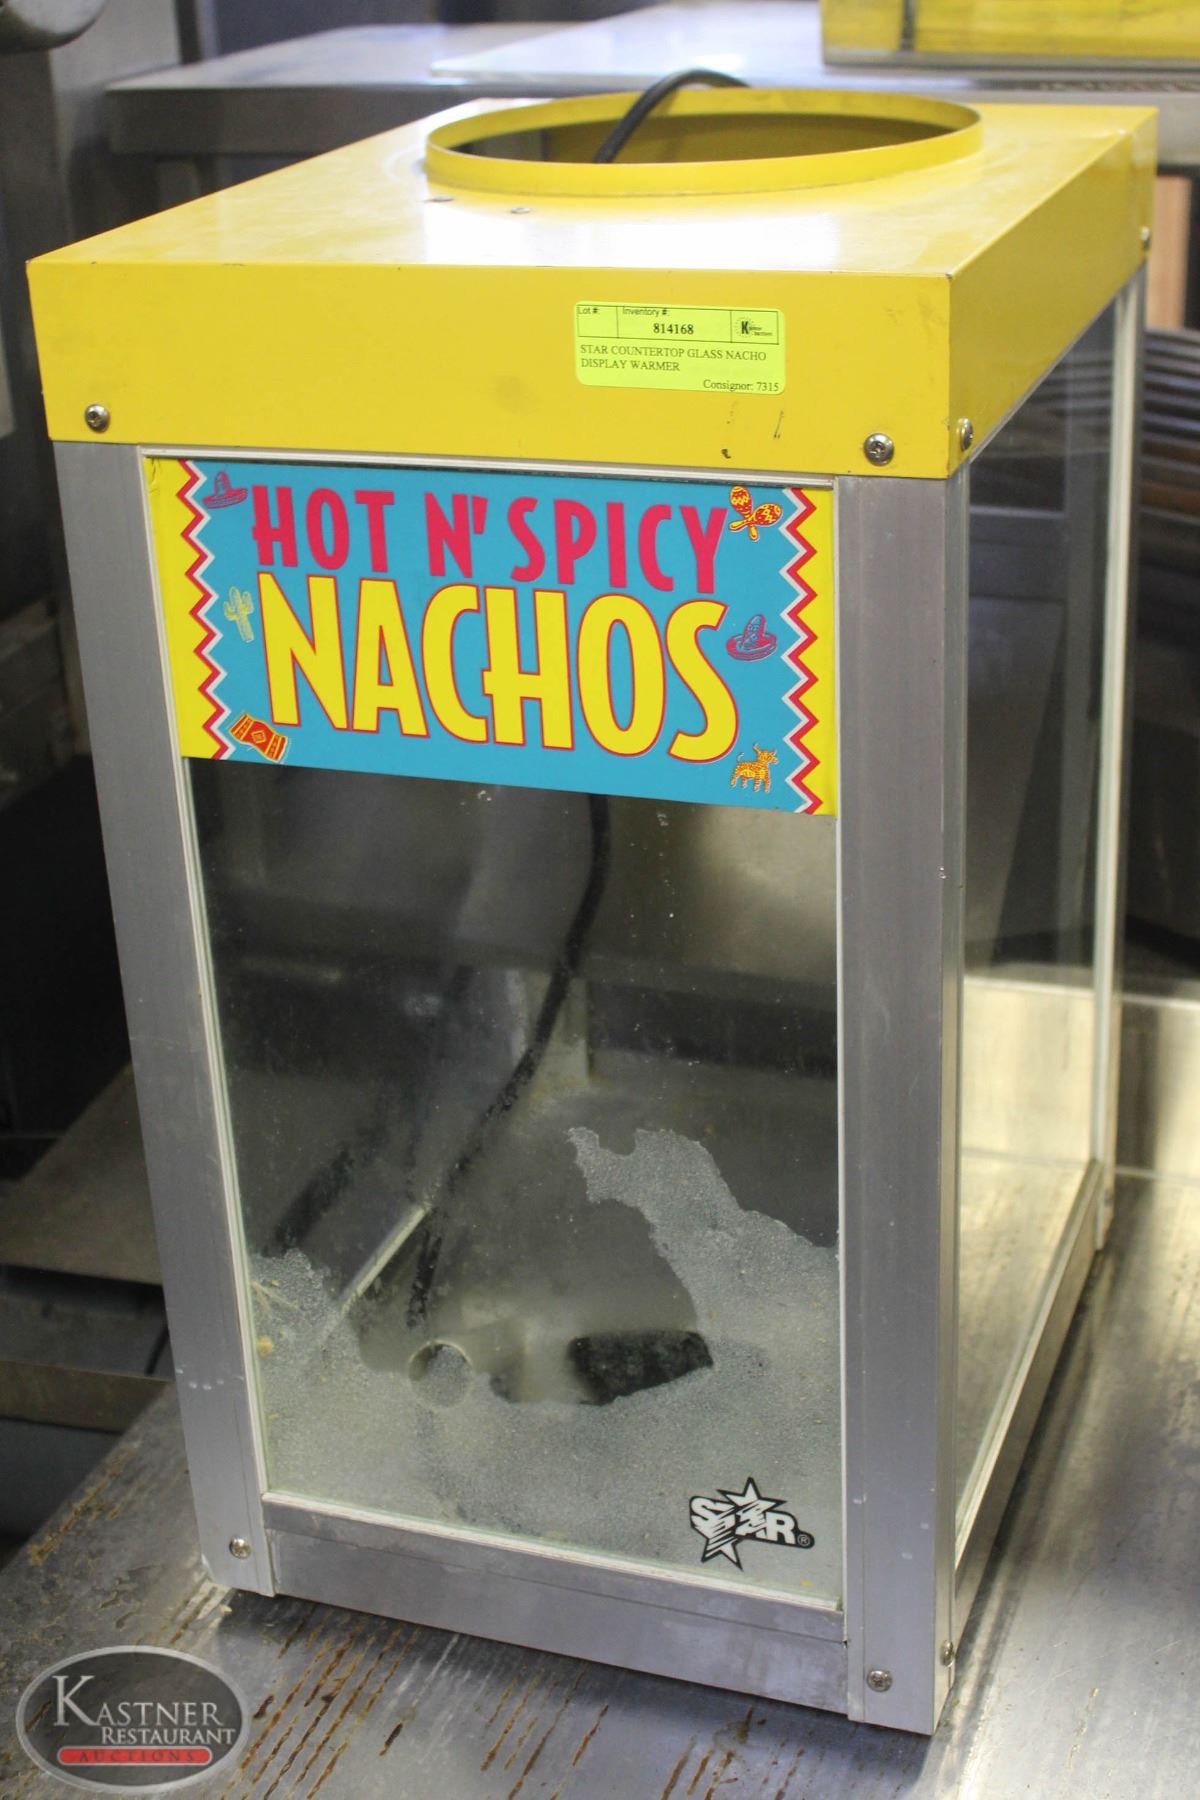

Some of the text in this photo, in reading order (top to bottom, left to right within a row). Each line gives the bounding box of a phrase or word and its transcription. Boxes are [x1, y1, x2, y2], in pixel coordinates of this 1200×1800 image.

[576, 306, 591, 315] Lot
[622, 307, 660, 317] Inventory
[653, 323, 694, 335] 814168
[580, 344, 767, 361] STAR COUNTERTOP GLASS NACHO
[581, 358, 680, 372] DISPLAY WARMER
[703, 379, 779, 392] Consignor: 7315
[252, 484, 728, 594] HOT N' SPICY
[257, 571, 740, 763] NACHOS
